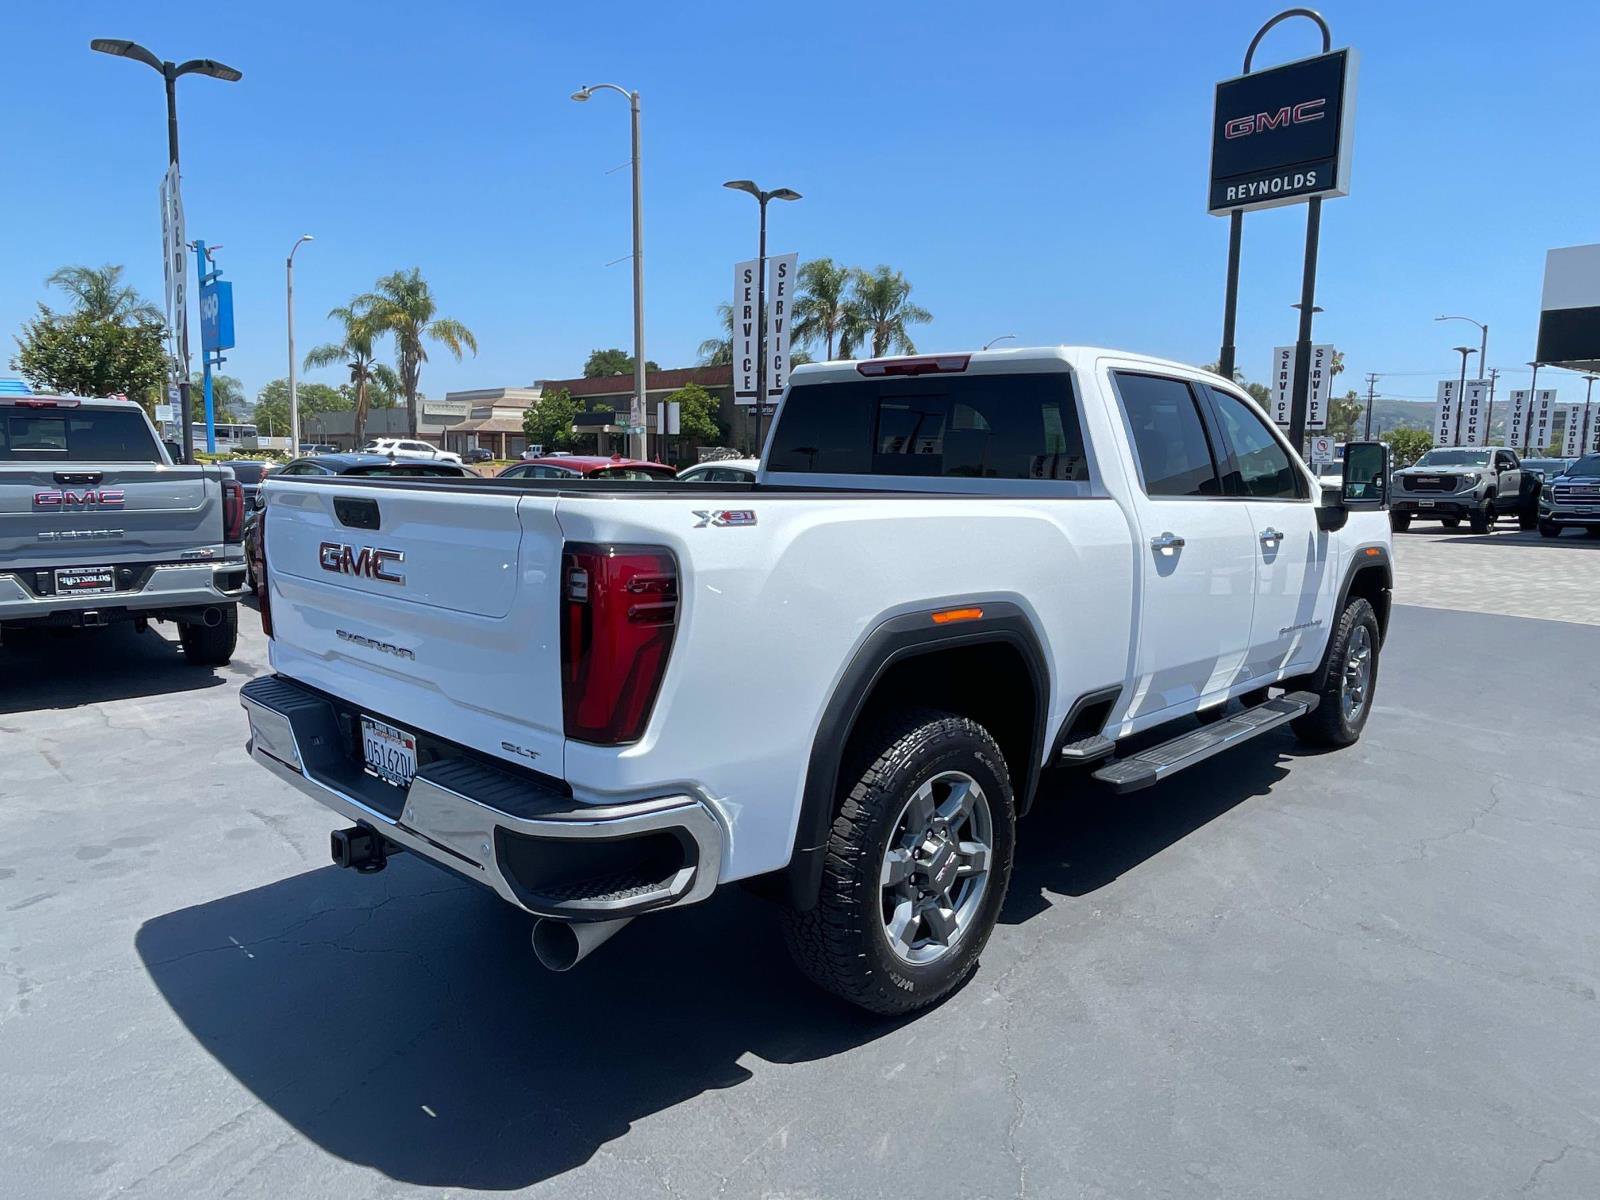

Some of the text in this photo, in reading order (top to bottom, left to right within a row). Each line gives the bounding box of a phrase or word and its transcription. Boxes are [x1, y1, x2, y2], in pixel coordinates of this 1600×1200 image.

[1224, 98, 1326, 140] GMC
[1226, 170, 1317, 201] REYNOLDS
[743, 269, 752, 390] SERVICE
[775, 263, 787, 388] SERVICE
[1279, 351, 1290, 421] SERVICE
[1311, 349, 1323, 421] SERVICE
[1440, 382, 1452, 444] REYNOLDS
[1468, 390, 1479, 443] TRUCKS
[1511, 392, 1524, 446] REYNOLDS
[1538, 392, 1549, 446] HUMMER
[33, 489, 125, 506] GMC
[319, 541, 406, 586] GMC
[335, 629, 416, 661] SIERRA
[501, 741, 541, 760] SLT
